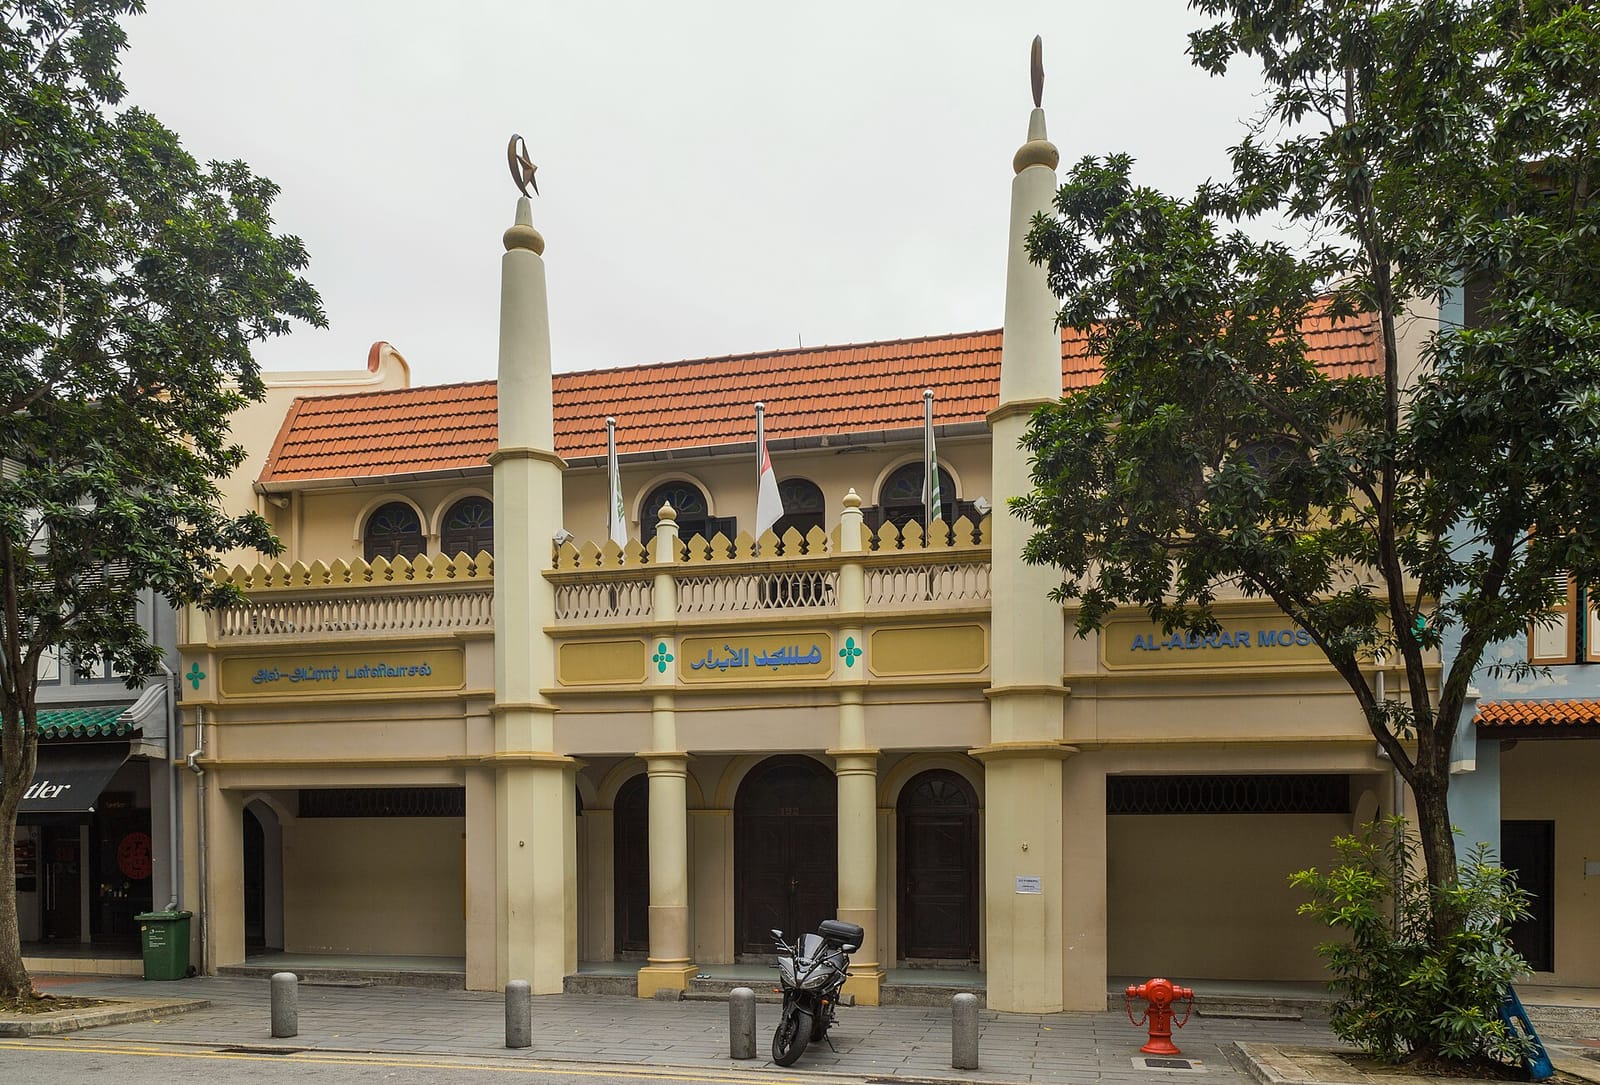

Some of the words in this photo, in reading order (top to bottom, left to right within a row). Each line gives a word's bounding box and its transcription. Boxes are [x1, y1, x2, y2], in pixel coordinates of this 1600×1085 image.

[1130, 631, 1251, 651] AL-ABRAR
[1258, 628, 1319, 648] MOS
[22, 780, 71, 800] tler
